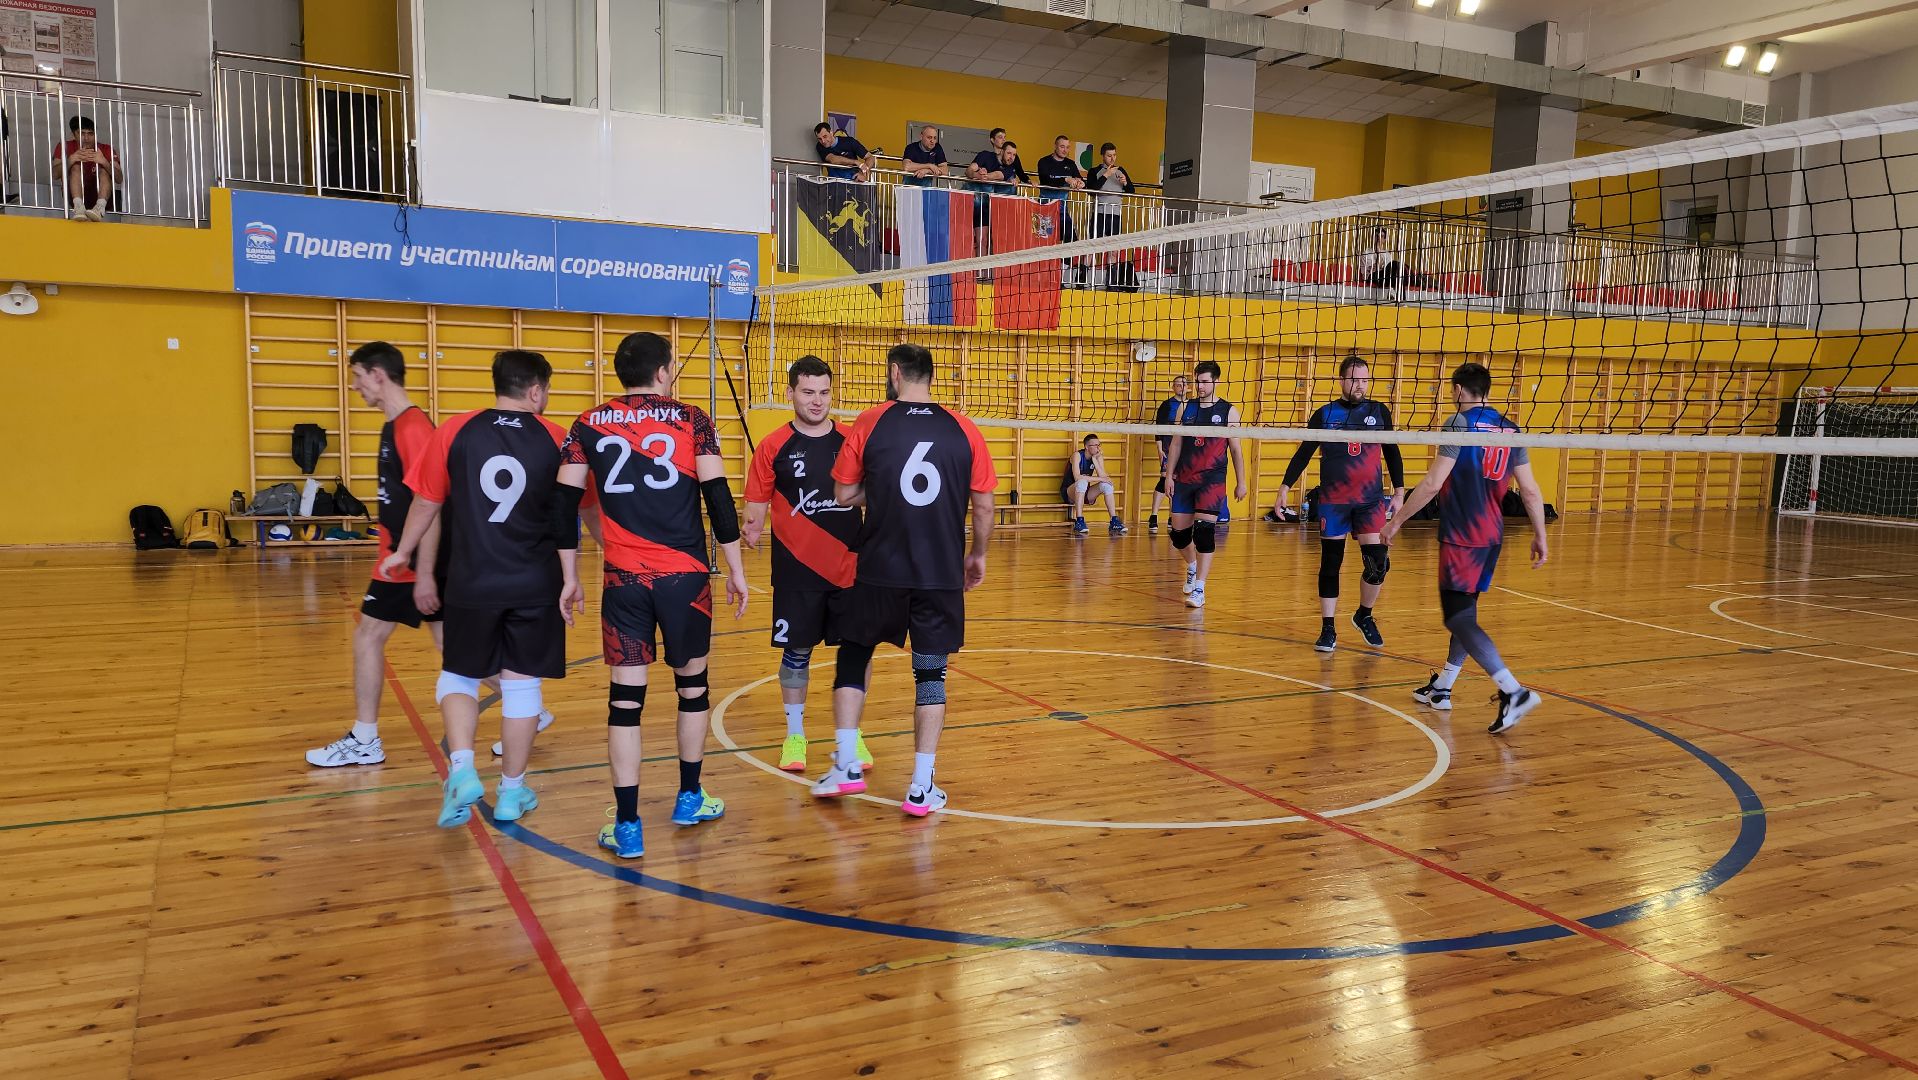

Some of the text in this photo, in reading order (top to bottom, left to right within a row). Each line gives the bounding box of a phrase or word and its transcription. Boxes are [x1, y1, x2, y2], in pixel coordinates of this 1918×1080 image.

[39, 3, 94, 15] БЕЗОПАСНОСТЬ
[284, 232, 723, 283] Привет участникам соревнований!
[589, 408, 682, 426] ПИВАРЧУК
[596, 432, 679, 494] 23
[793, 460, 806, 477] 2
[900, 442, 941, 507] 6
[1482, 446, 1511, 481] 10
[480, 455, 526, 523] 9
[774, 618, 789, 643] 2
